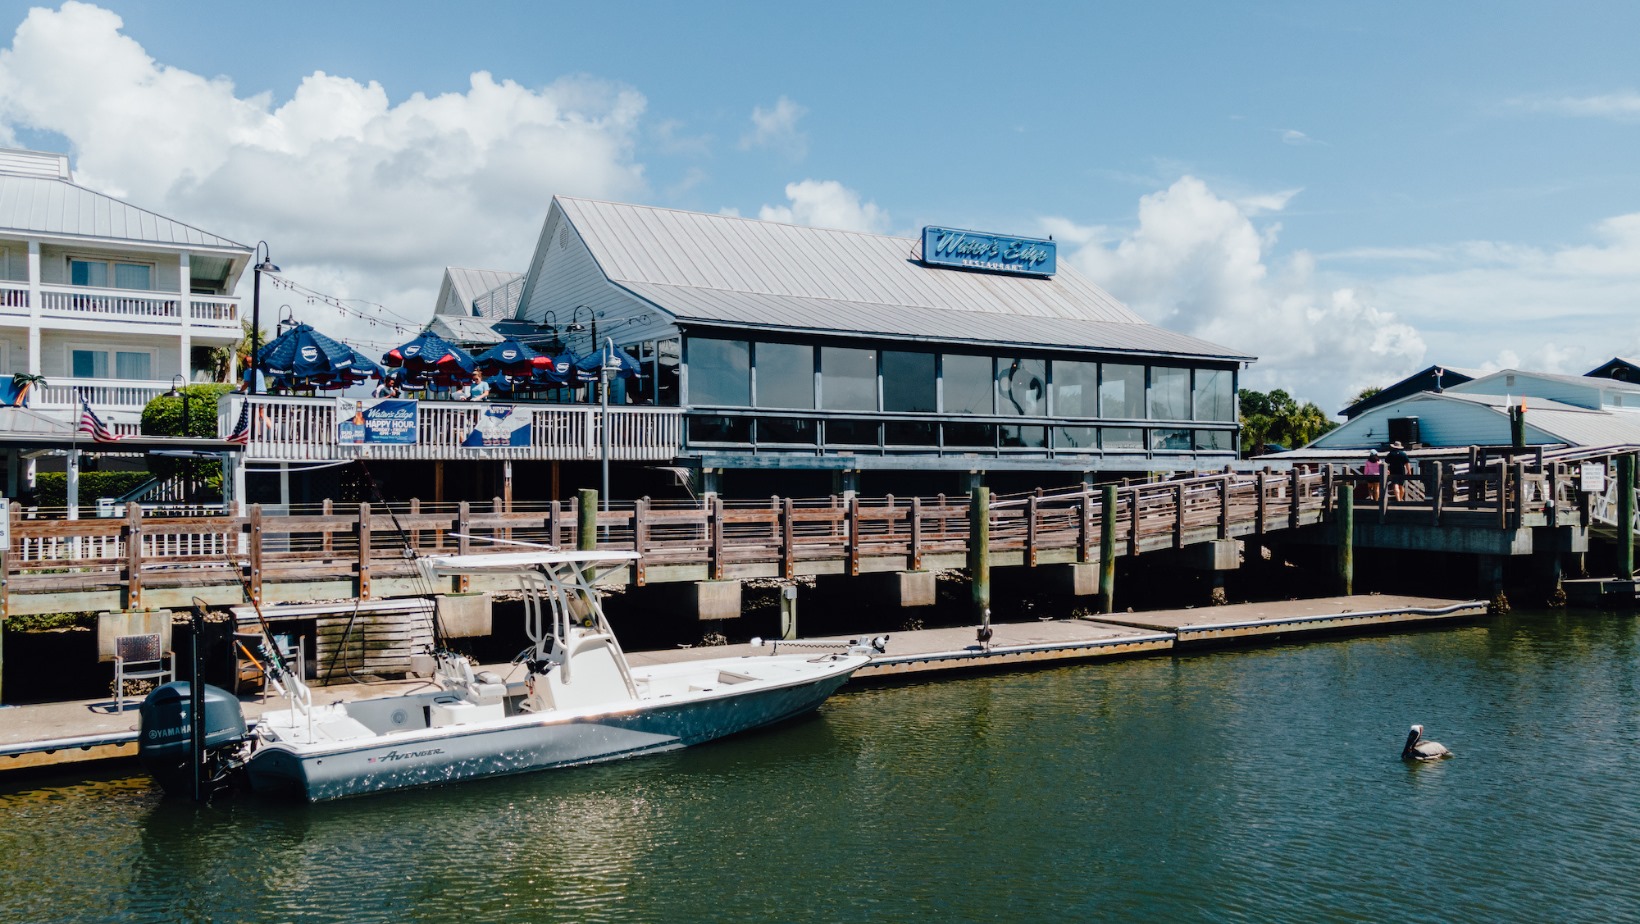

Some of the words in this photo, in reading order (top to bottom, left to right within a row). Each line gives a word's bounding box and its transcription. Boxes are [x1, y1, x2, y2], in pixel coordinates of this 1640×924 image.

[937, 230, 999, 257] Water's
[1003, 240, 1048, 267] Edge
[962, 259, 1023, 271] RESTAURANT
[367, 408, 395, 418] Water's
[394, 409, 414, 420] Edge
[365, 420, 391, 428] HAPPY
[157, 724, 191, 738] YAMAHA
